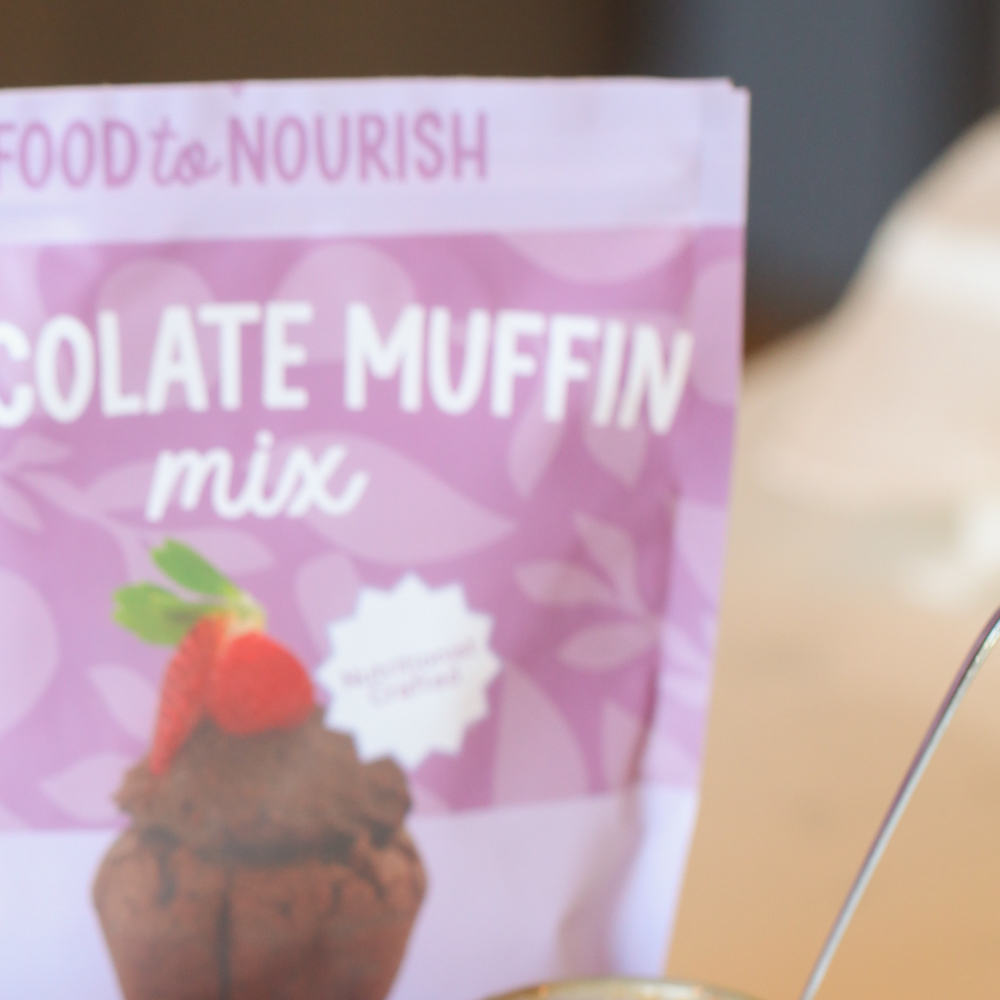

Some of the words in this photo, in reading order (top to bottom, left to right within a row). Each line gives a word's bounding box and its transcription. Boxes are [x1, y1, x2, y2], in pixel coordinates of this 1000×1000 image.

[149, 118, 221, 188] to
[228, 110, 489, 186] NOURISH
[344, 303, 692, 435] MUFFIN
[147, 430, 368, 522] mix
